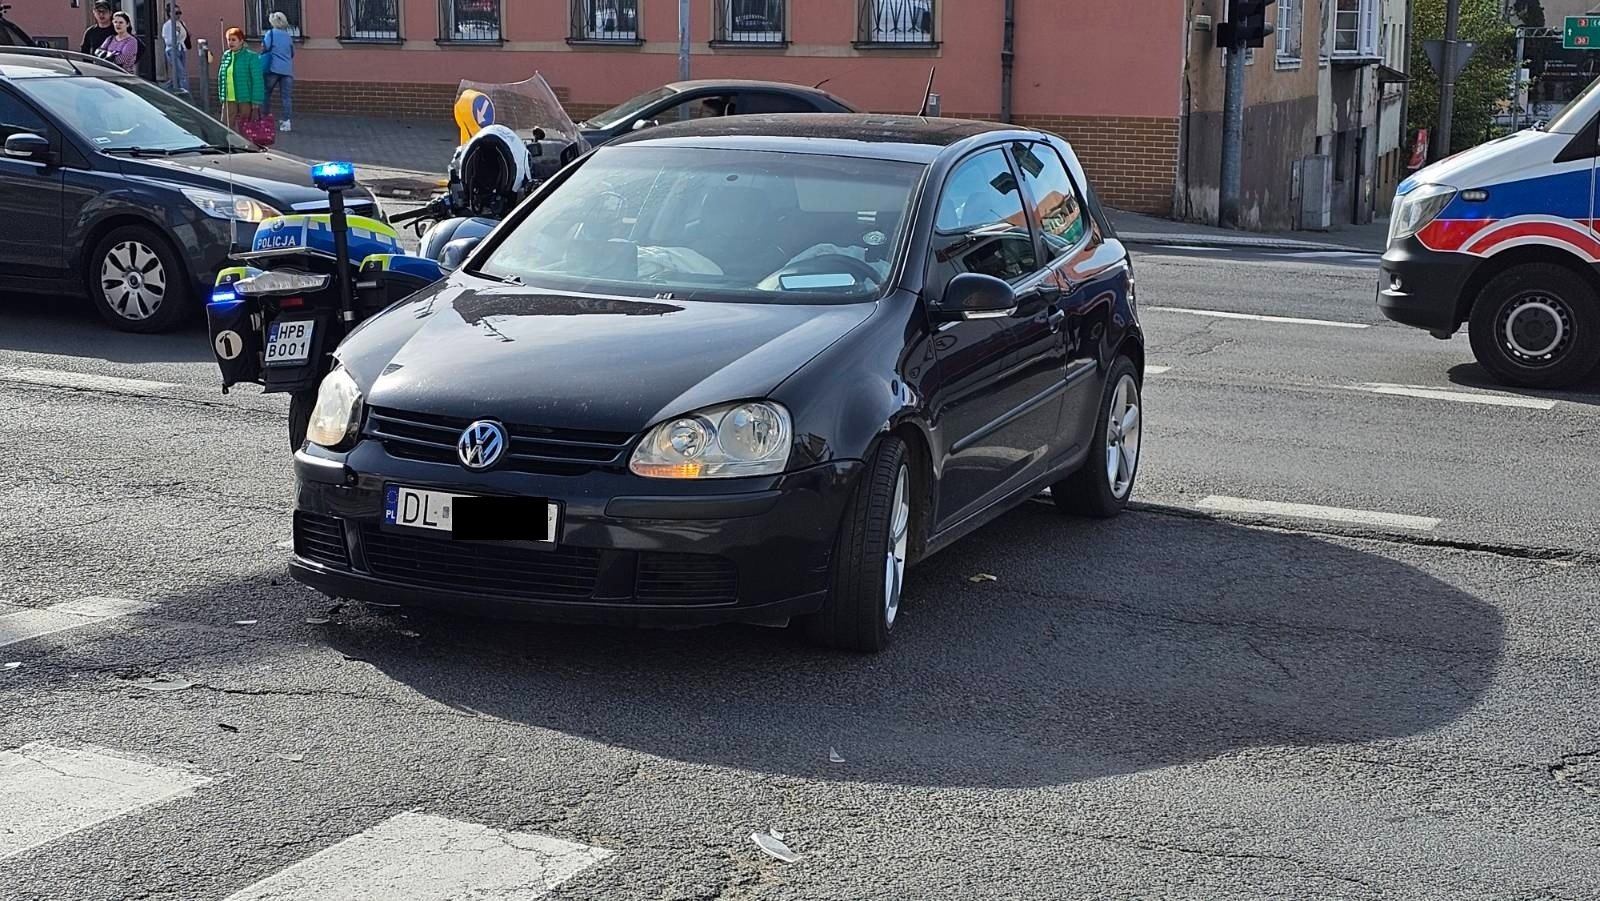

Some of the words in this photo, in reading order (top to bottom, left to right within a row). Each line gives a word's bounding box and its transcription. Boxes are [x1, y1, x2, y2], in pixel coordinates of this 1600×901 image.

[256, 235, 296, 250] POLICJA
[279, 324, 305, 339] HPB
[268, 342, 306, 358] B001
[385, 509, 396, 520] PL
